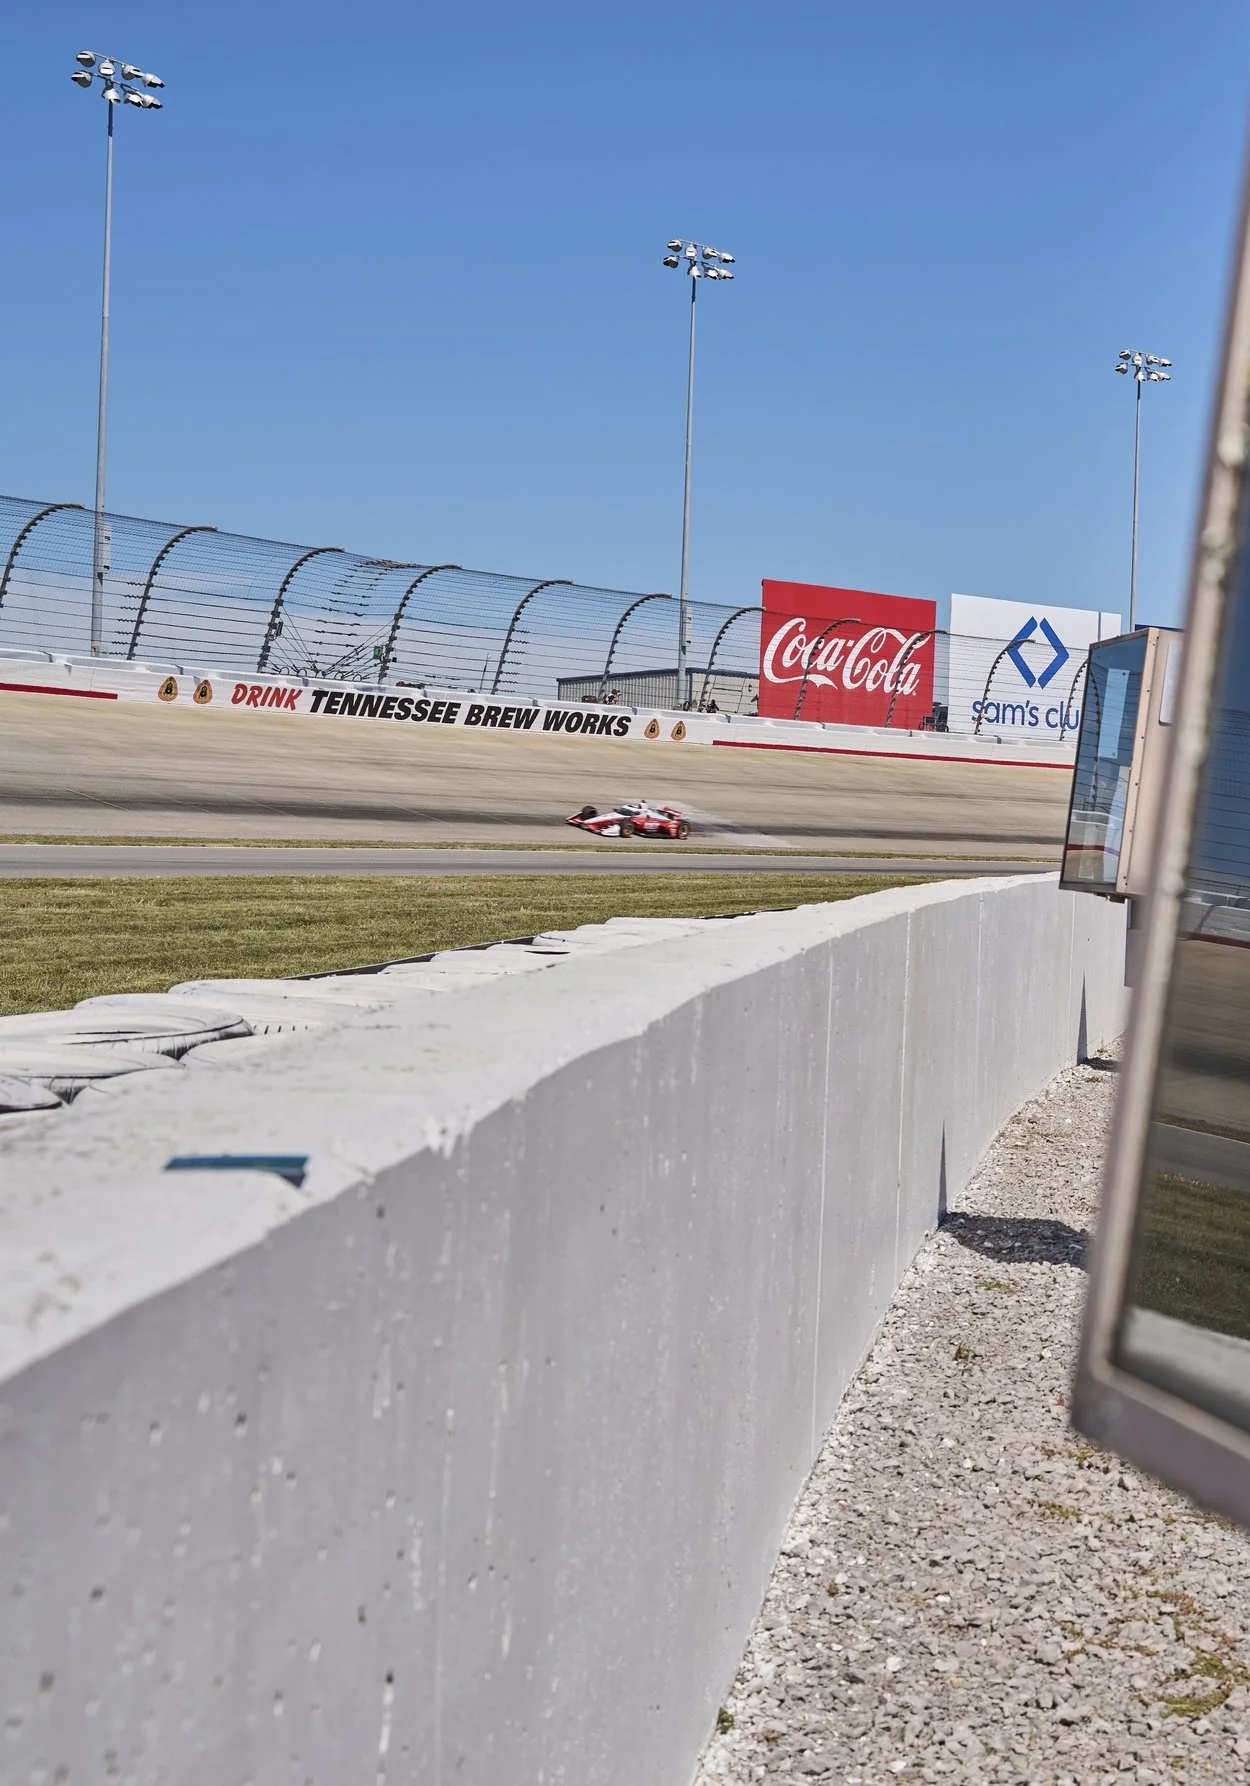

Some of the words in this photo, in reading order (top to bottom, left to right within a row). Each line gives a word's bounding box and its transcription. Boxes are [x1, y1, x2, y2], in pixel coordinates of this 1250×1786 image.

[763, 617, 931, 695] Coca-Cola
[231, 683, 303, 711] DRINK
[309, 689, 462, 724] TENNESSEE
[464, 703, 540, 730] BREW
[542, 709, 631, 737] WORKS
[971, 700, 1040, 727] sam's
[1045, 701, 1080, 730] clu
